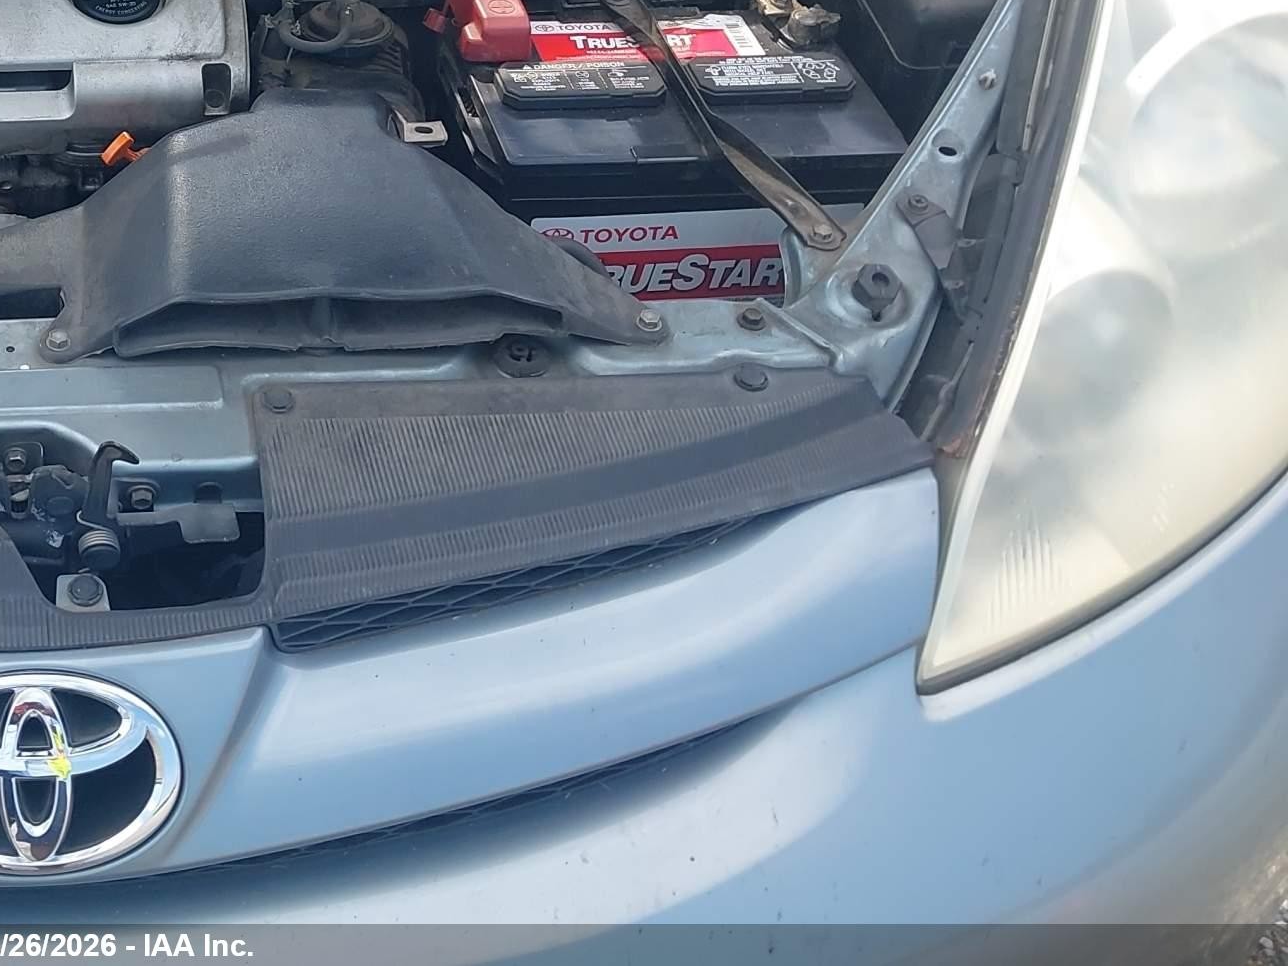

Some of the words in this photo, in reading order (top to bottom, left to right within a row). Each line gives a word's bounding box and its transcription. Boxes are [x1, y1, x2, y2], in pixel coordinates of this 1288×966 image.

[556, 23, 611, 32] TOYOTA
[533, 62, 578, 70] DANGER
[587, 61, 625, 69] POISON
[580, 226, 679, 244] TOYOTA
